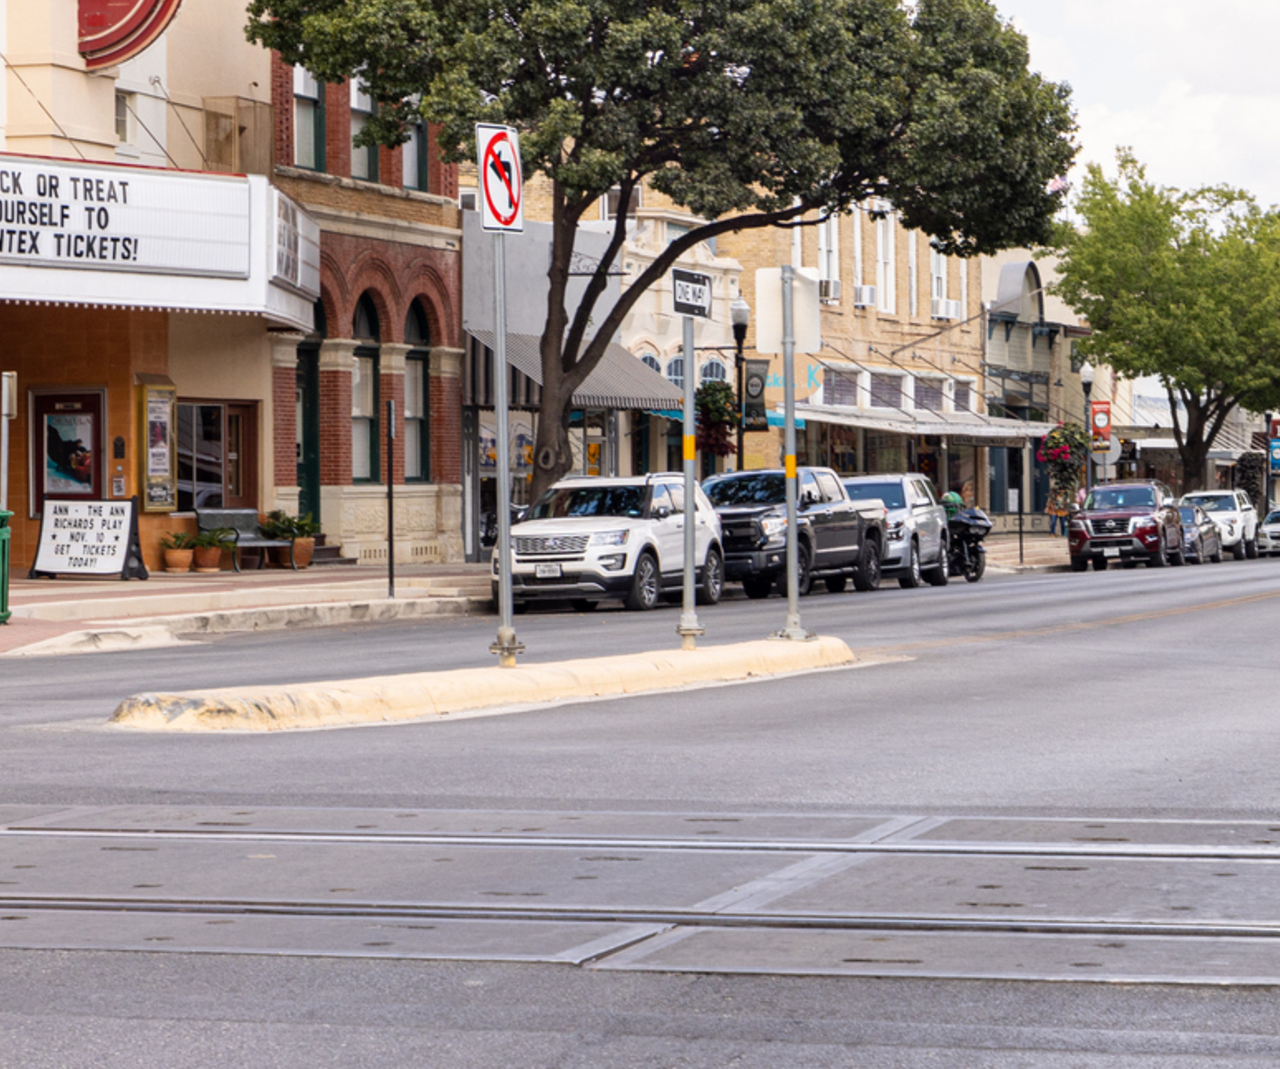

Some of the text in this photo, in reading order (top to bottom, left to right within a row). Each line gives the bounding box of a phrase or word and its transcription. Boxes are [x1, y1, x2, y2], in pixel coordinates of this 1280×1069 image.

[36, 173, 59, 198] OR
[70, 177, 129, 204] TREAT
[85, 206, 109, 230] TO
[53, 233, 139, 261] TICKETS!
[677, 282, 705, 304] ONE WAY
[52, 505, 69, 515] ANN
[88, 505, 103, 516] THE
[109, 506, 125, 516] ANN
[53, 518, 123, 530] RICHARDS PLAY
[69, 532, 88, 542] NOV.
[54, 544, 116, 556] GET TICKETS
[68, 556, 97, 567] TODAY!
